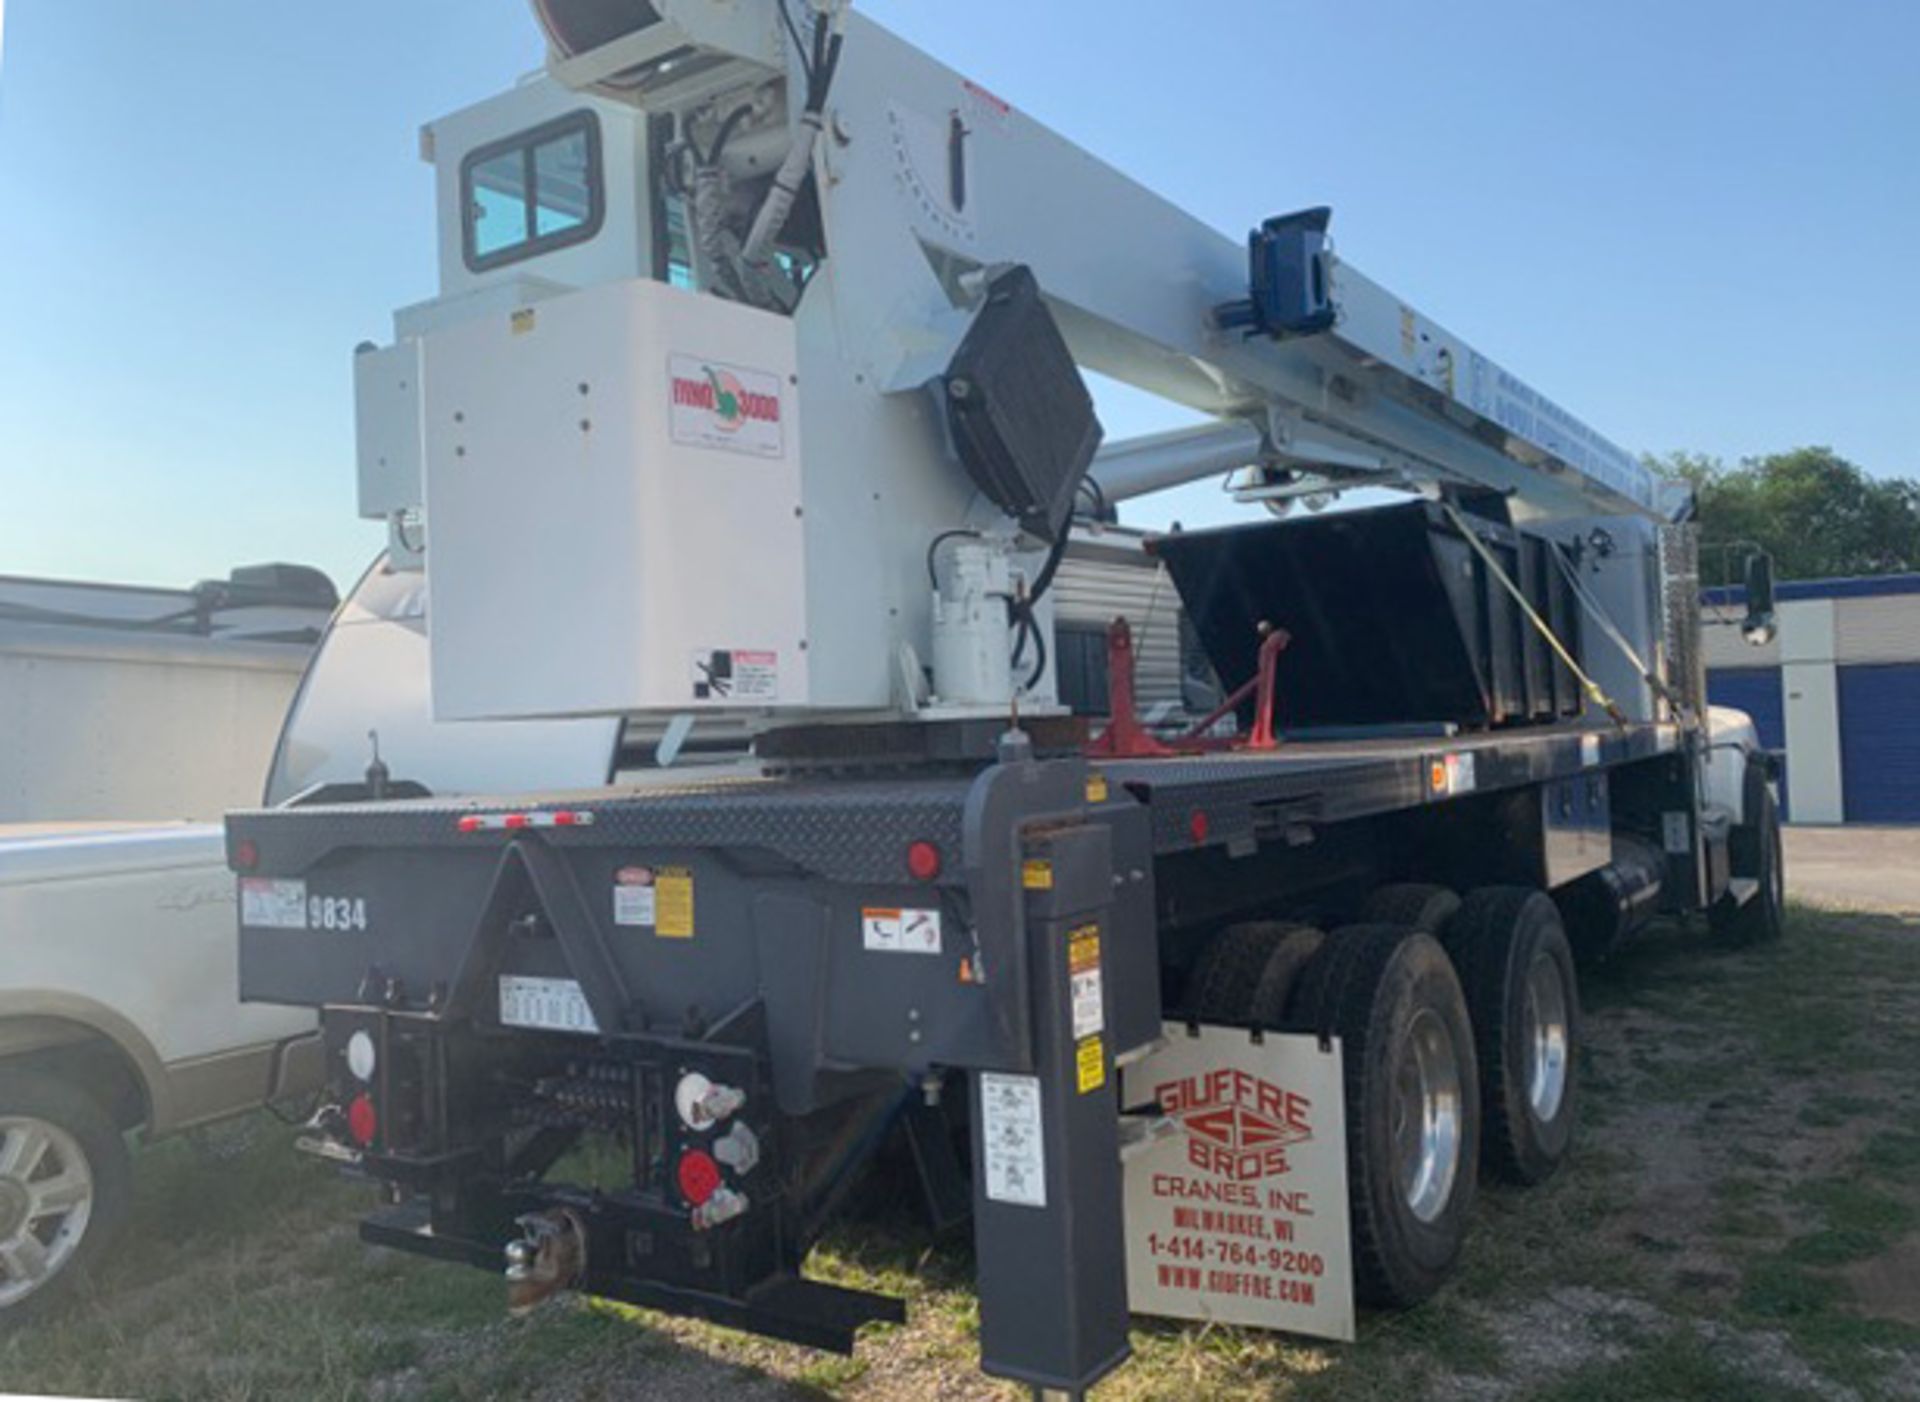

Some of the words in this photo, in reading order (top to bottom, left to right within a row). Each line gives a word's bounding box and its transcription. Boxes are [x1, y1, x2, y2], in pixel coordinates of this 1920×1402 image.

[309, 895, 366, 931] 9834
[1154, 1068, 1313, 1134] GIUFFRE
[1189, 1138, 1291, 1181] BROS.
[1153, 1174, 1262, 1209] CRANES,
[1274, 1219, 1294, 1241] WI
[1148, 1233, 1324, 1278] 1-414-764-9200
[1157, 1264, 1315, 1305] WWW.GIUFFRE.COM
